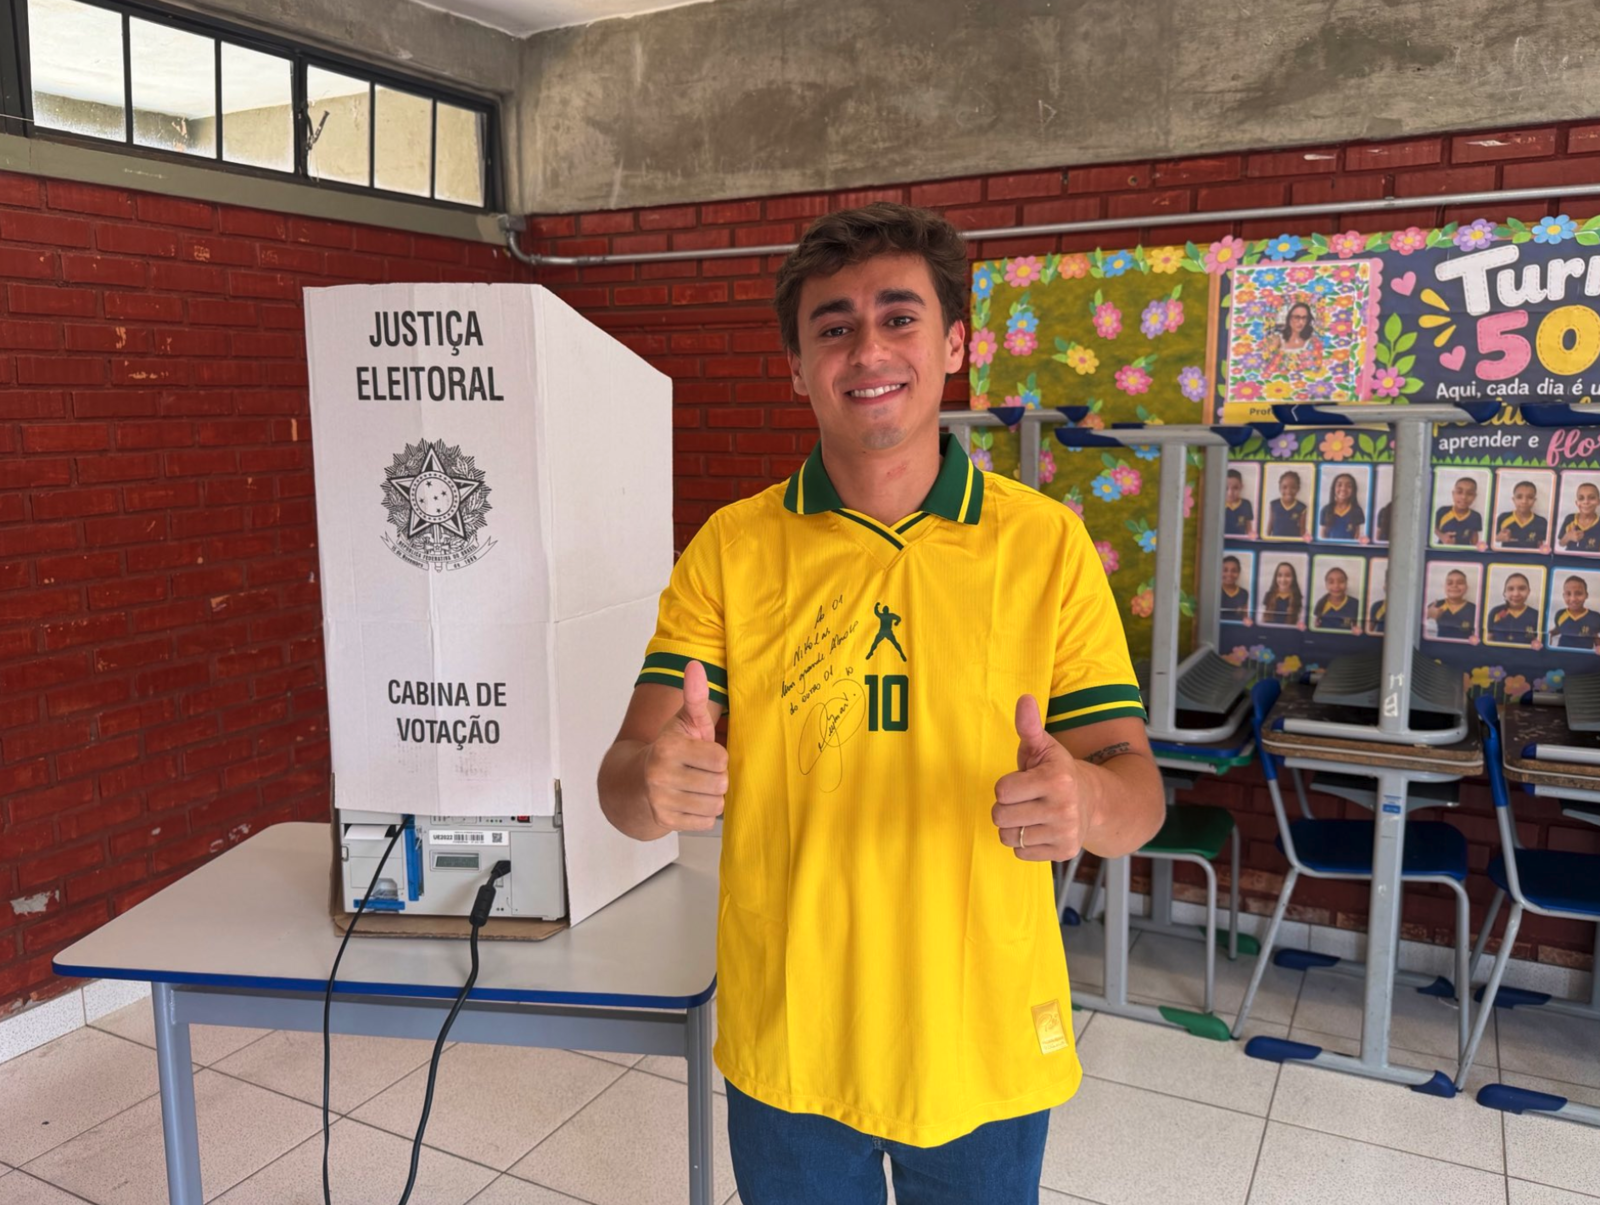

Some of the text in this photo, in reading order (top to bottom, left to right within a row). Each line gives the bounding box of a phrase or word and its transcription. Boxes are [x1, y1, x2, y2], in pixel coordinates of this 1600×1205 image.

[369, 309, 484, 356] JUSTIÇA
[356, 366, 504, 402] ELEITORAL
[1436, 377, 1600, 401] Aqui, cada dia é u
[1249, 407, 1271, 415] Prof
[1438, 430, 1522, 454] aprender
[1528, 435, 1540, 448] e
[388, 679, 507, 707] CABINA DE
[864, 674, 909, 732] 10
[396, 714, 500, 751] VOTAÇÃO
